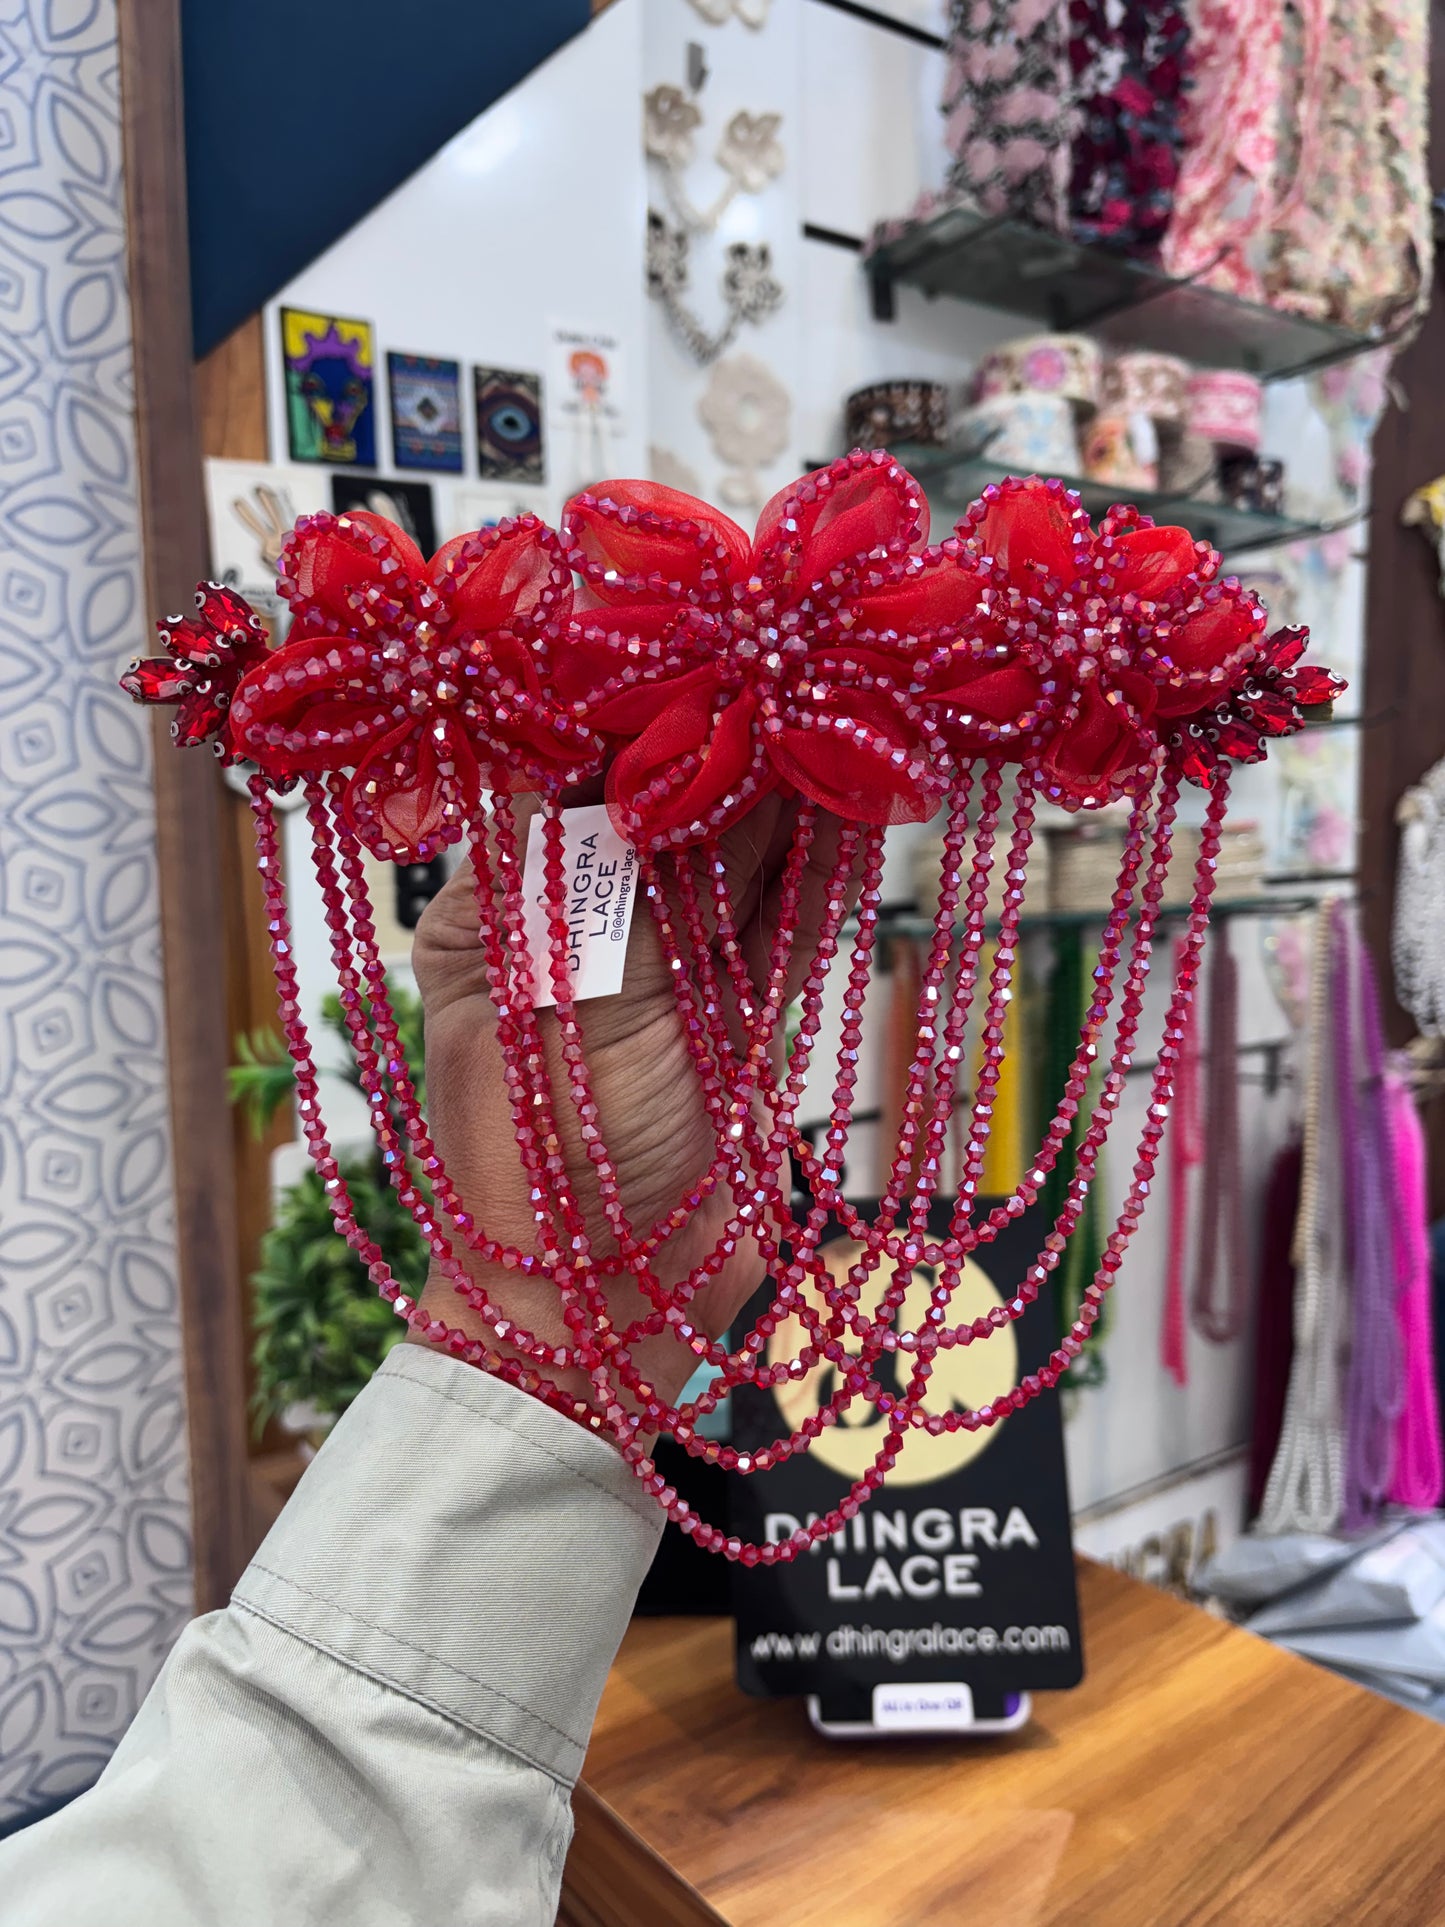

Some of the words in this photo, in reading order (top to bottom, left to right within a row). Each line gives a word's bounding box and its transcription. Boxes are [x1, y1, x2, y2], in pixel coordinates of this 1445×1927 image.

[588, 859, 618, 937] LACE
[612, 848, 635, 929] @dhingra_lace
[827, 1553, 983, 1599] LACE
